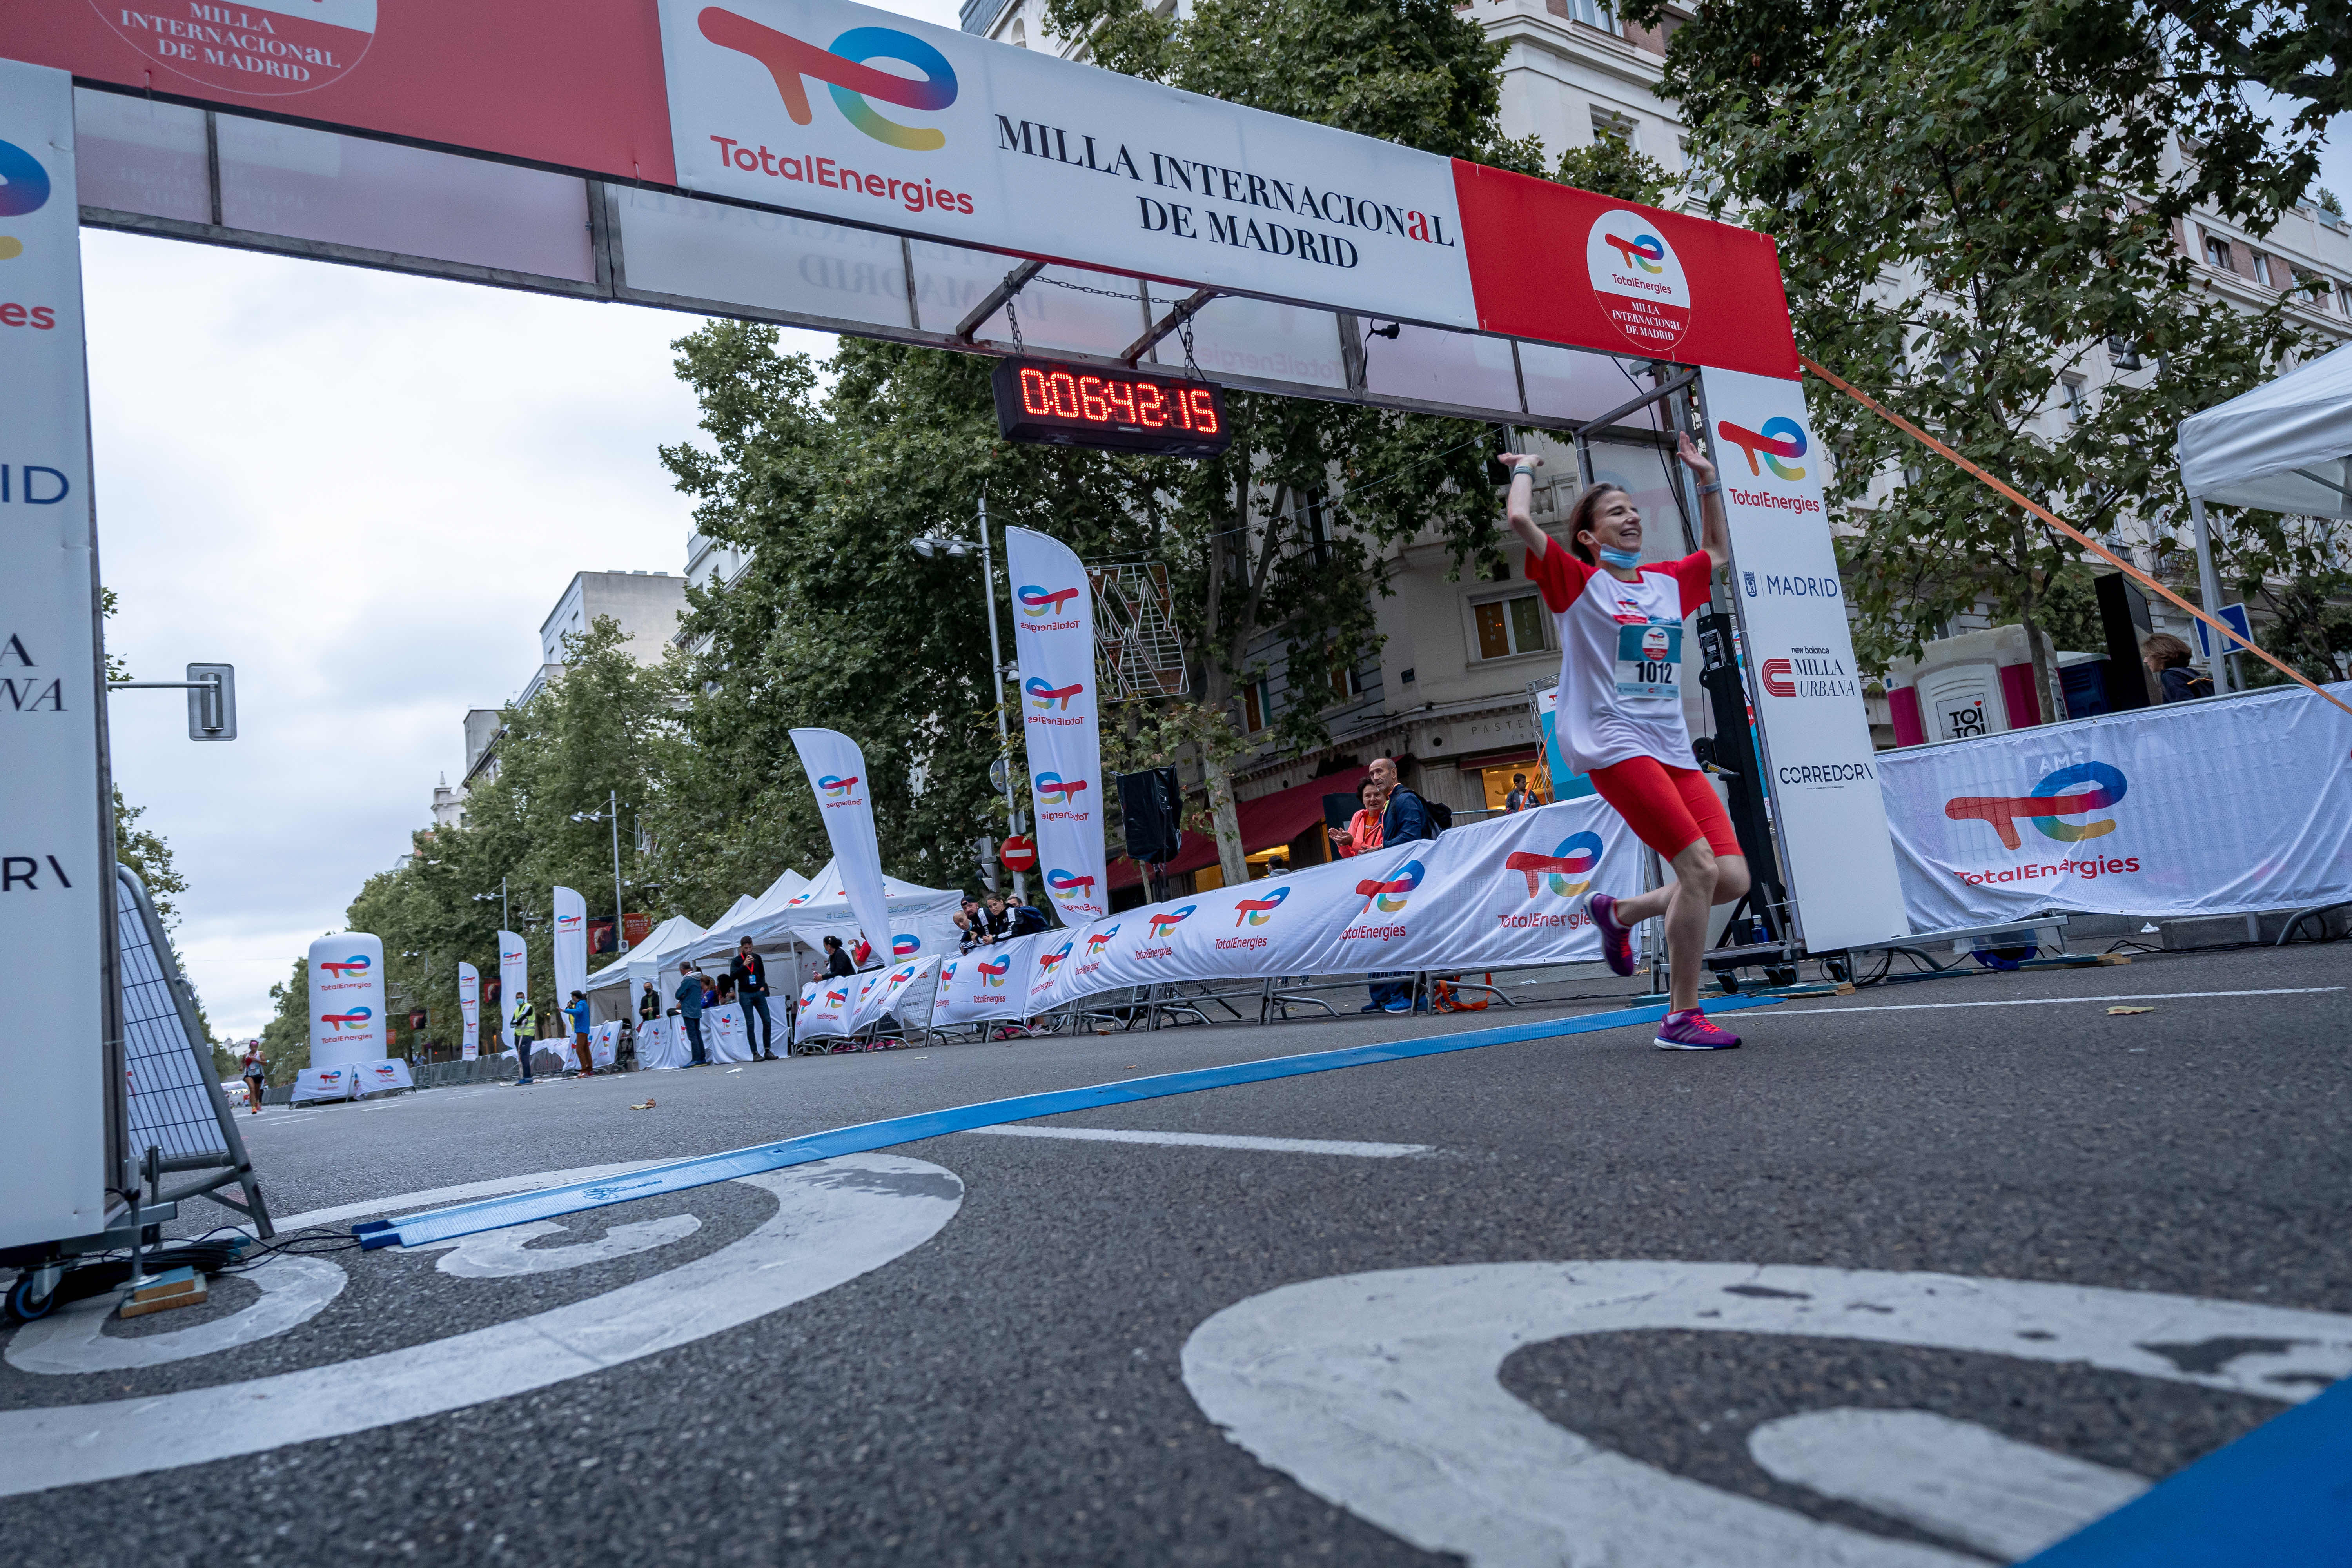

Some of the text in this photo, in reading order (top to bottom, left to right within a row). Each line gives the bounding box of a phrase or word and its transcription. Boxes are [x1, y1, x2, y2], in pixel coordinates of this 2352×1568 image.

[189, 2, 276, 35] MILLA
[158, 38, 310, 82] DE MADRID
[995, 114, 1144, 181] MILLA
[710, 134, 974, 214] TotalEnergies
[1136, 196, 1359, 268] DE MADRID
[1612, 273, 1672, 295] TotalEnergies
[1632, 301, 1661, 315] MILLA
[1625, 324, 1674, 341] DE MADRID
[1728, 488, 1820, 515] TotalEnergies
[1766, 575, 1838, 597] MADRID
[1804, 646, 1829, 654] balance
[1635, 661, 1673, 684] 1012
[1794, 659, 1845, 675] MILLA
[1799, 680, 1857, 697] URBANA
[1949, 707, 1984, 726] TOI
[1953, 855, 2140, 886] TotalEnergies
[1498, 909, 1591, 930] TotalEnergie
[1135, 944, 1172, 961] TotalEnergies
[1215, 935, 1268, 951] TotalEnergies
[321, 982, 372, 991] TotalEnergies
[973, 994, 1006, 1005] TotalEnergies
[321, 1034, 373, 1044] TotalEnergies
